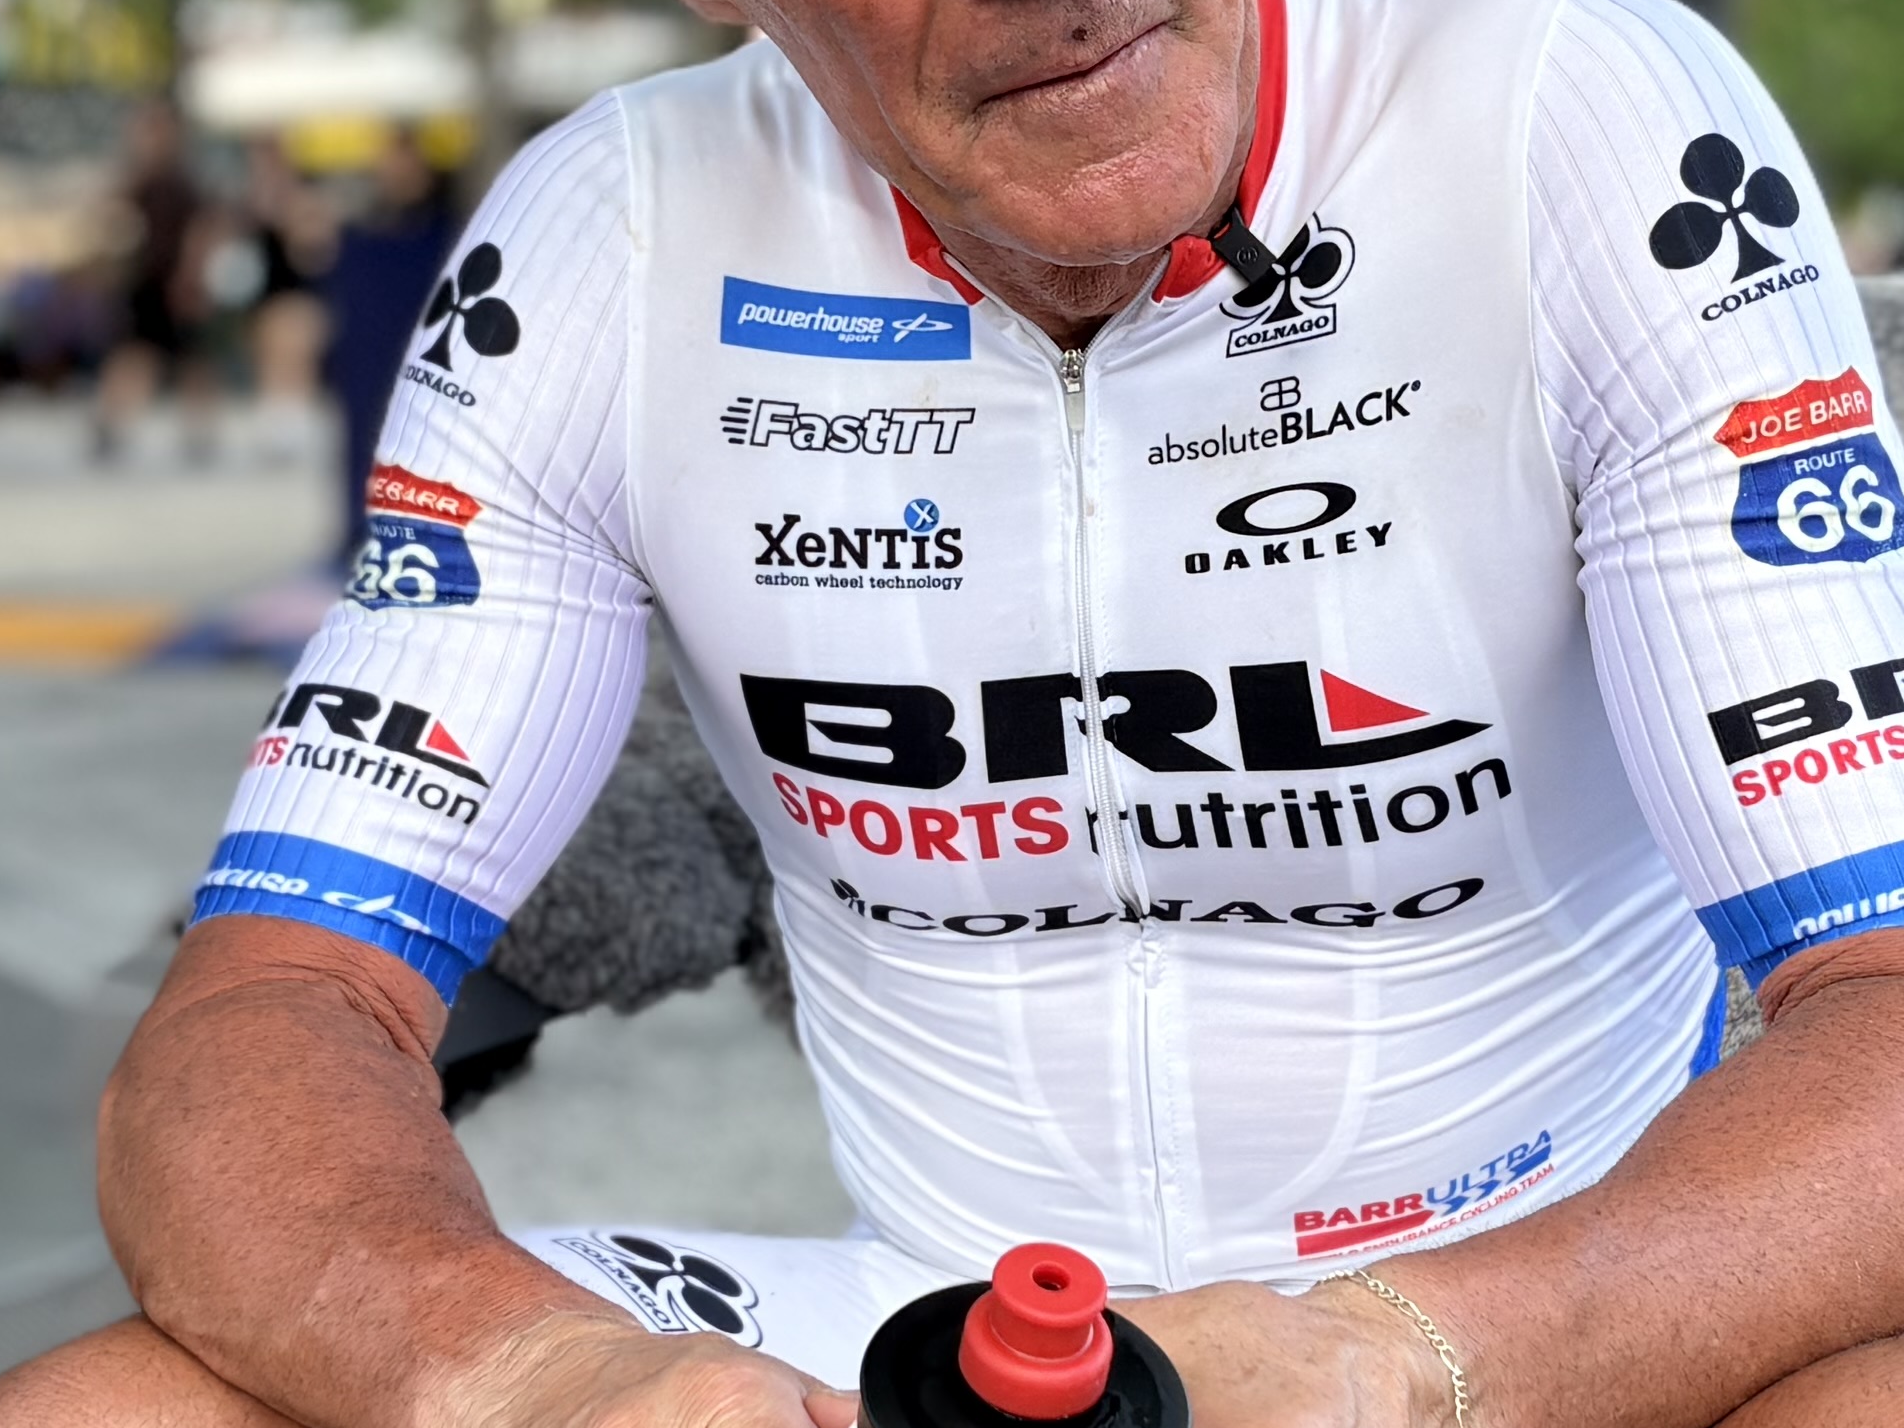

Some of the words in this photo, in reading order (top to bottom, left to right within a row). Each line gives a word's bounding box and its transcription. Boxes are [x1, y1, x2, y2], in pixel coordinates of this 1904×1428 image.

[738, 302, 884, 334] powerhouse
[1701, 264, 1820, 322] COLNAGO
[838, 333, 881, 343] sport
[1234, 315, 1329, 349] COLNAGO
[405, 365, 476, 407] OLNAGO
[749, 399, 976, 455] FastTT
[1741, 408, 1802, 444] JOE
[1809, 390, 1868, 426] BARR
[1795, 448, 1856, 475] ROUTE
[1777, 464, 1896, 553] 66
[1185, 521, 1392, 574] OAKLEY
[755, 572, 810, 587] carbon
[815, 574, 863, 589] wheel
[869, 575, 963, 590] technology
[261, 683, 490, 789] RL
[740, 660, 1493, 790] BRL
[286, 742, 480, 824] nutrition
[871, 877, 1484, 935] COLNAGO
[1520, 1163, 1555, 1190] TEAM
[569, 1241, 671, 1324] COLNAGO
